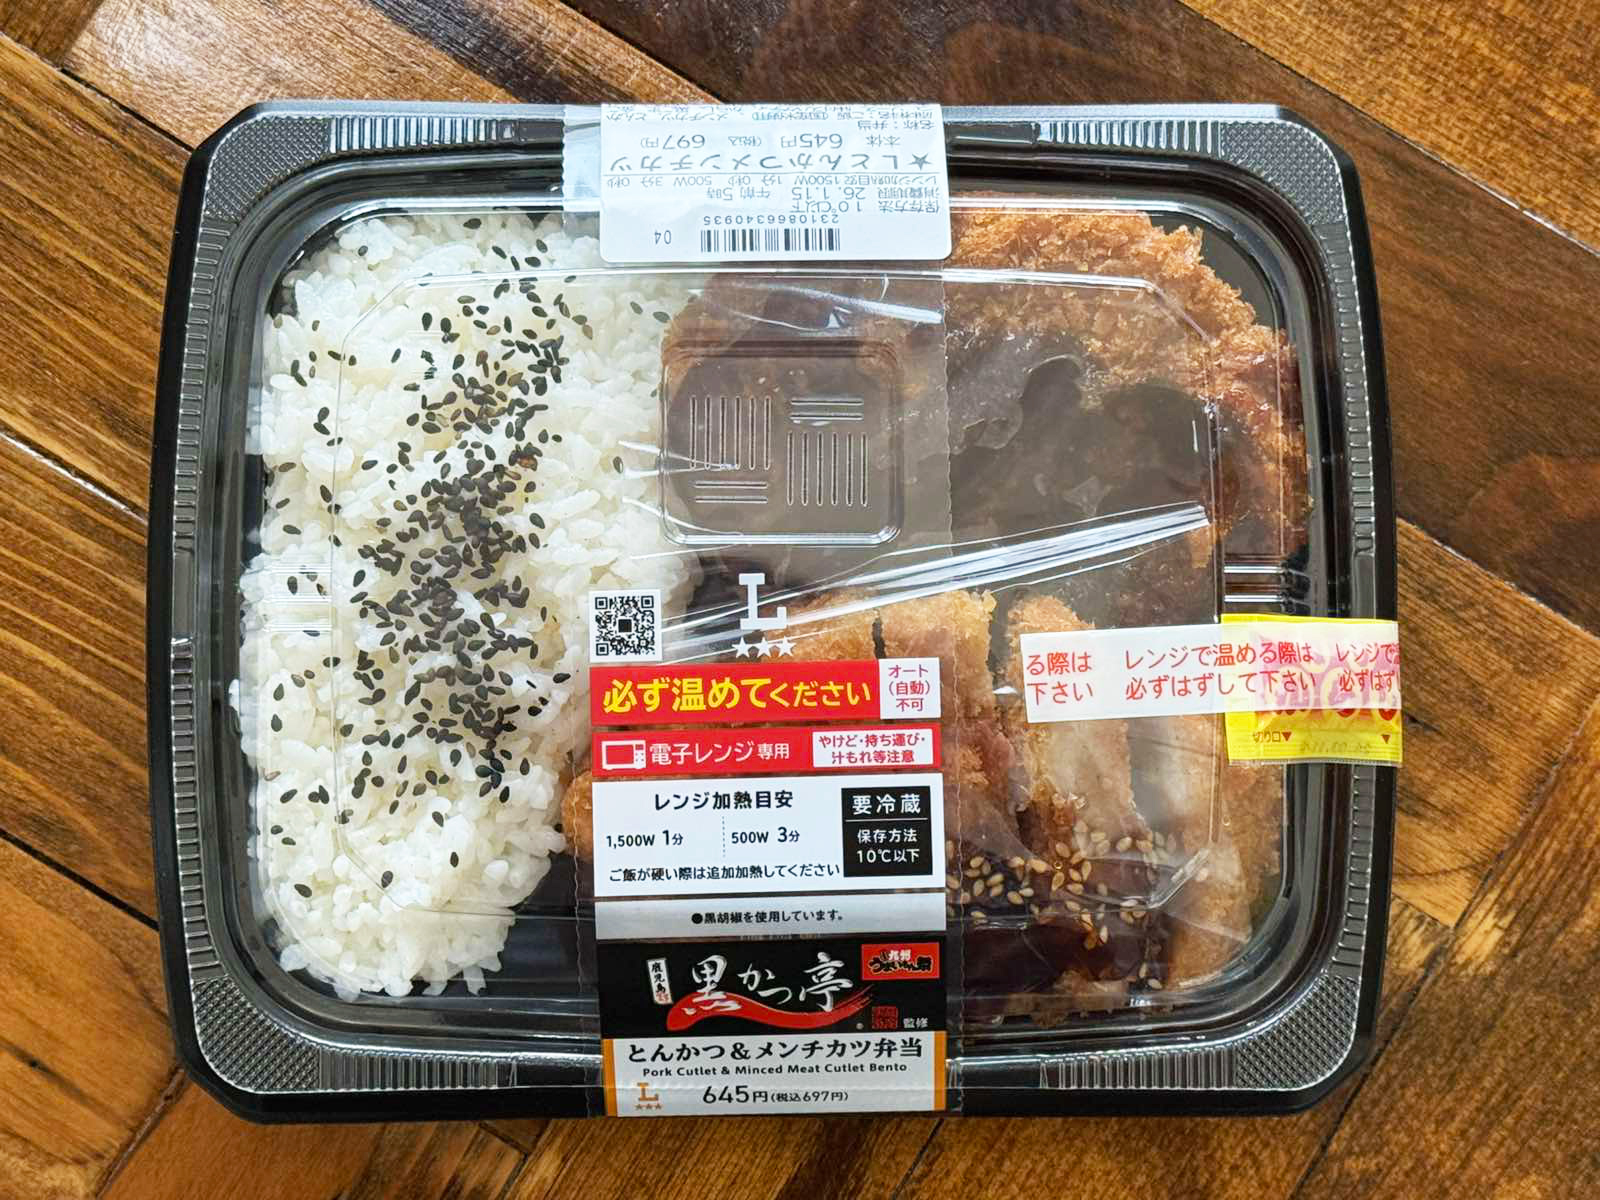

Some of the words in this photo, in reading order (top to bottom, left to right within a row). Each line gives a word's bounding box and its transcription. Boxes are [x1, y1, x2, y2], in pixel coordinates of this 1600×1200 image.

[780, 134, 843, 148] 645円
[866, 135, 900, 146] 本体
[640, 177, 663, 187] 3分
[673, 176, 712, 186] 500W
[761, 176, 782, 185] 1分
[740, 187, 770, 199] 午前
[877, 187, 939, 199] 消費期限
[879, 201, 939, 213] 保存方法
[703, 214, 838, 225] 2310866340935
[654, 230, 671, 245] 04
[739, 572, 787, 630] L
[1026, 651, 1092, 676] る際は
[1125, 641, 1314, 670] レンジで温める際は
[888, 665, 929, 676] オート
[1026, 682, 1093, 706] 下さい
[1125, 670, 1315, 700] 必ずはずして下さい
[603, 677, 870, 714] 必ず温めてください
[896, 698, 924, 712] 不可
[1253, 732, 1281, 743] 切り口
[831, 750, 914, 765] 汁もれ等注意
[654, 790, 794, 811] レンジ加熱目安
[852, 794, 921, 815] 要冷蔵
[606, 834, 655, 849] 1,500W
[662, 830, 683, 846] 1分
[731, 831, 769, 844] 500W
[777, 827, 800, 843] 3分
[857, 829, 918, 844] 保存方法
[609, 864, 840, 883] ご飯が硬い際は追加加熱してください
[680, 951, 854, 1016] 黒かつ亭
[904, 1018, 928, 1028] 監修
[643, 1066, 672, 1077] Pork
[677, 1065, 717, 1076] Cutlet
[721, 1065, 730, 1075] &
[736, 1064, 783, 1075] Minced
[787, 1063, 820, 1074] Meat
[825, 1062, 864, 1073] Cutlet
[869, 1062, 907, 1072] Bento
